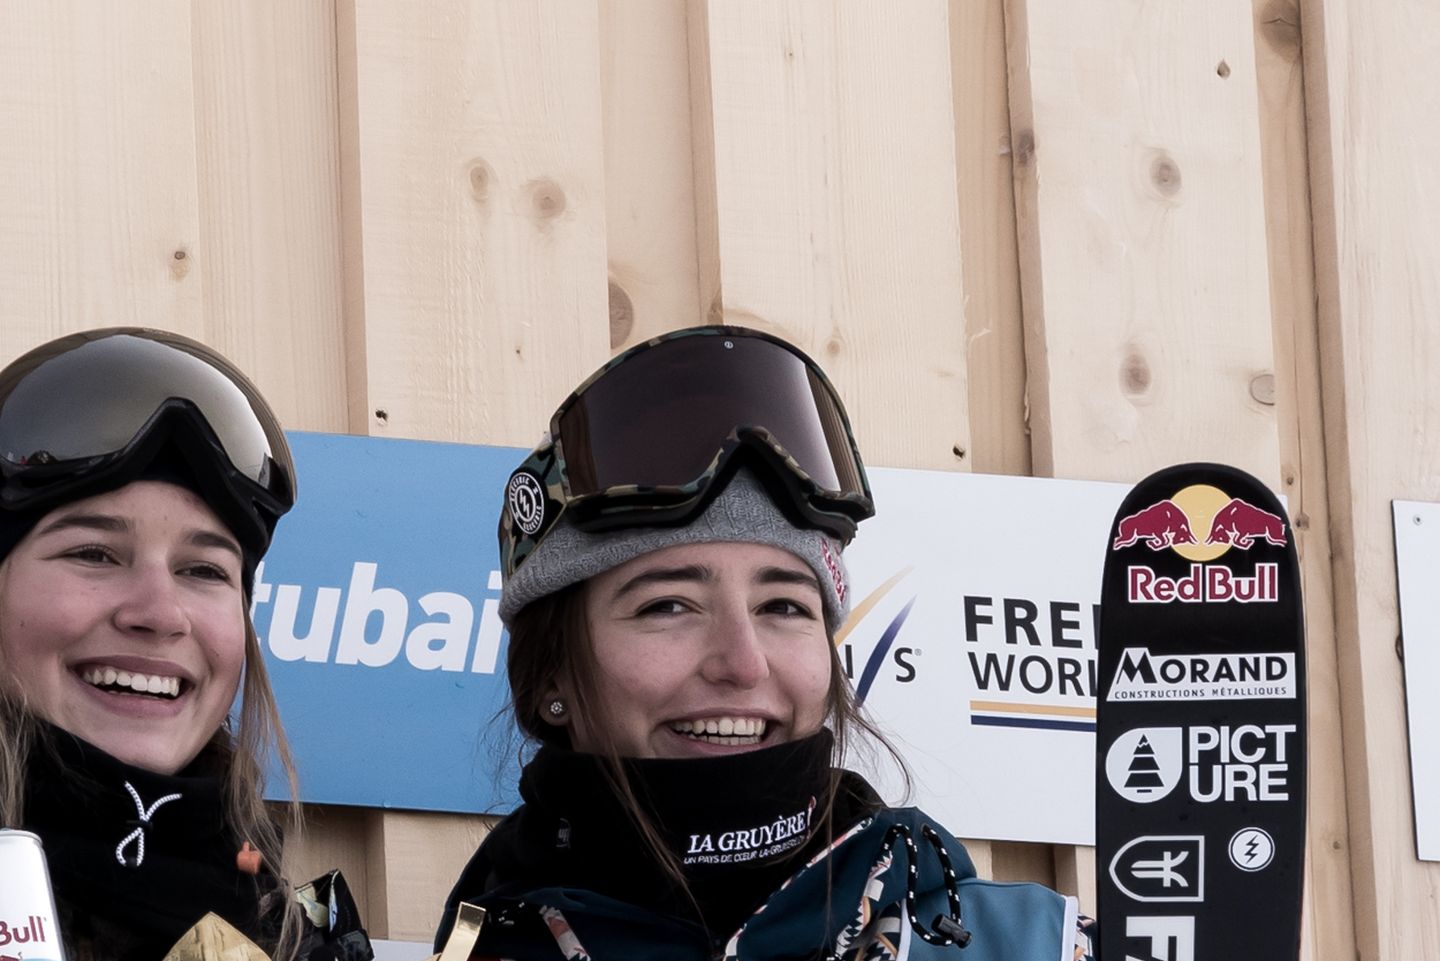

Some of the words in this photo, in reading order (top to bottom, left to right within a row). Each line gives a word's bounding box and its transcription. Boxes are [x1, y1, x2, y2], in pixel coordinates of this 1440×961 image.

[1129, 565, 1202, 602] Red
[1206, 563, 1277, 602] Bull
[250, 560, 504, 674] tubai
[963, 595, 1101, 650] FRE
[843, 644, 917, 684] IS
[1116, 650, 1288, 685] MORAND
[1114, 688, 1206, 700] CONSTRUCTIONS
[1211, 685, 1288, 697] MÉTALLIQUES
[1188, 724, 1297, 764] PICT
[1188, 763, 1289, 803] URE
[687, 834, 715, 853] LA
[718, 811, 806, 852] GRUYÈRE
[698, 854, 720, 864] PAYS
